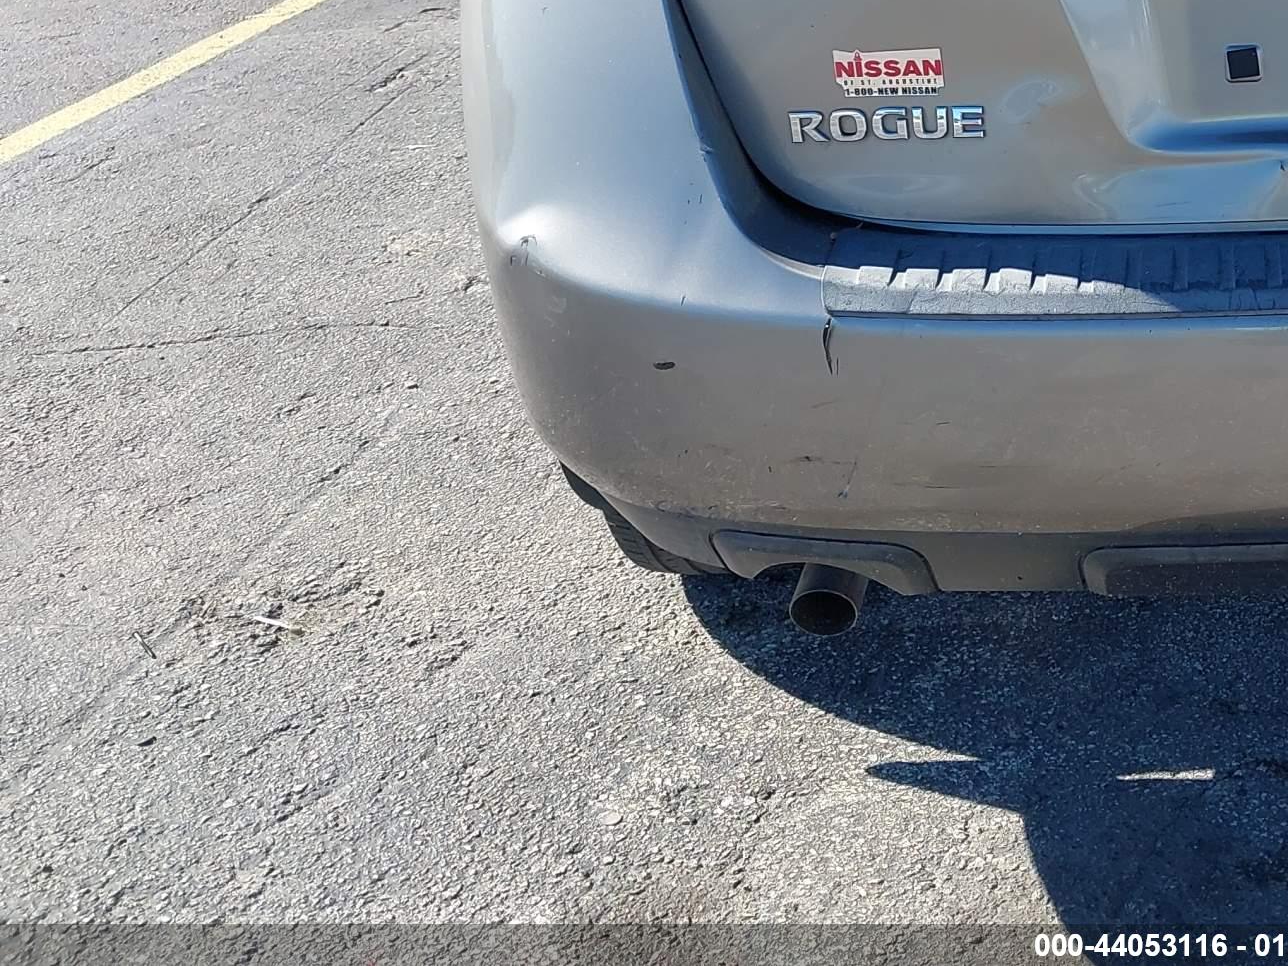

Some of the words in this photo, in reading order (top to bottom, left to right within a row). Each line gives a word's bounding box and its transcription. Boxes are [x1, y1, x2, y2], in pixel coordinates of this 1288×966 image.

[835, 58, 943, 78] NISSAN
[845, 87, 899, 96] 1-800-NEW
[901, 86, 938, 95] NISSAN
[788, 106, 986, 143] ROGUE
